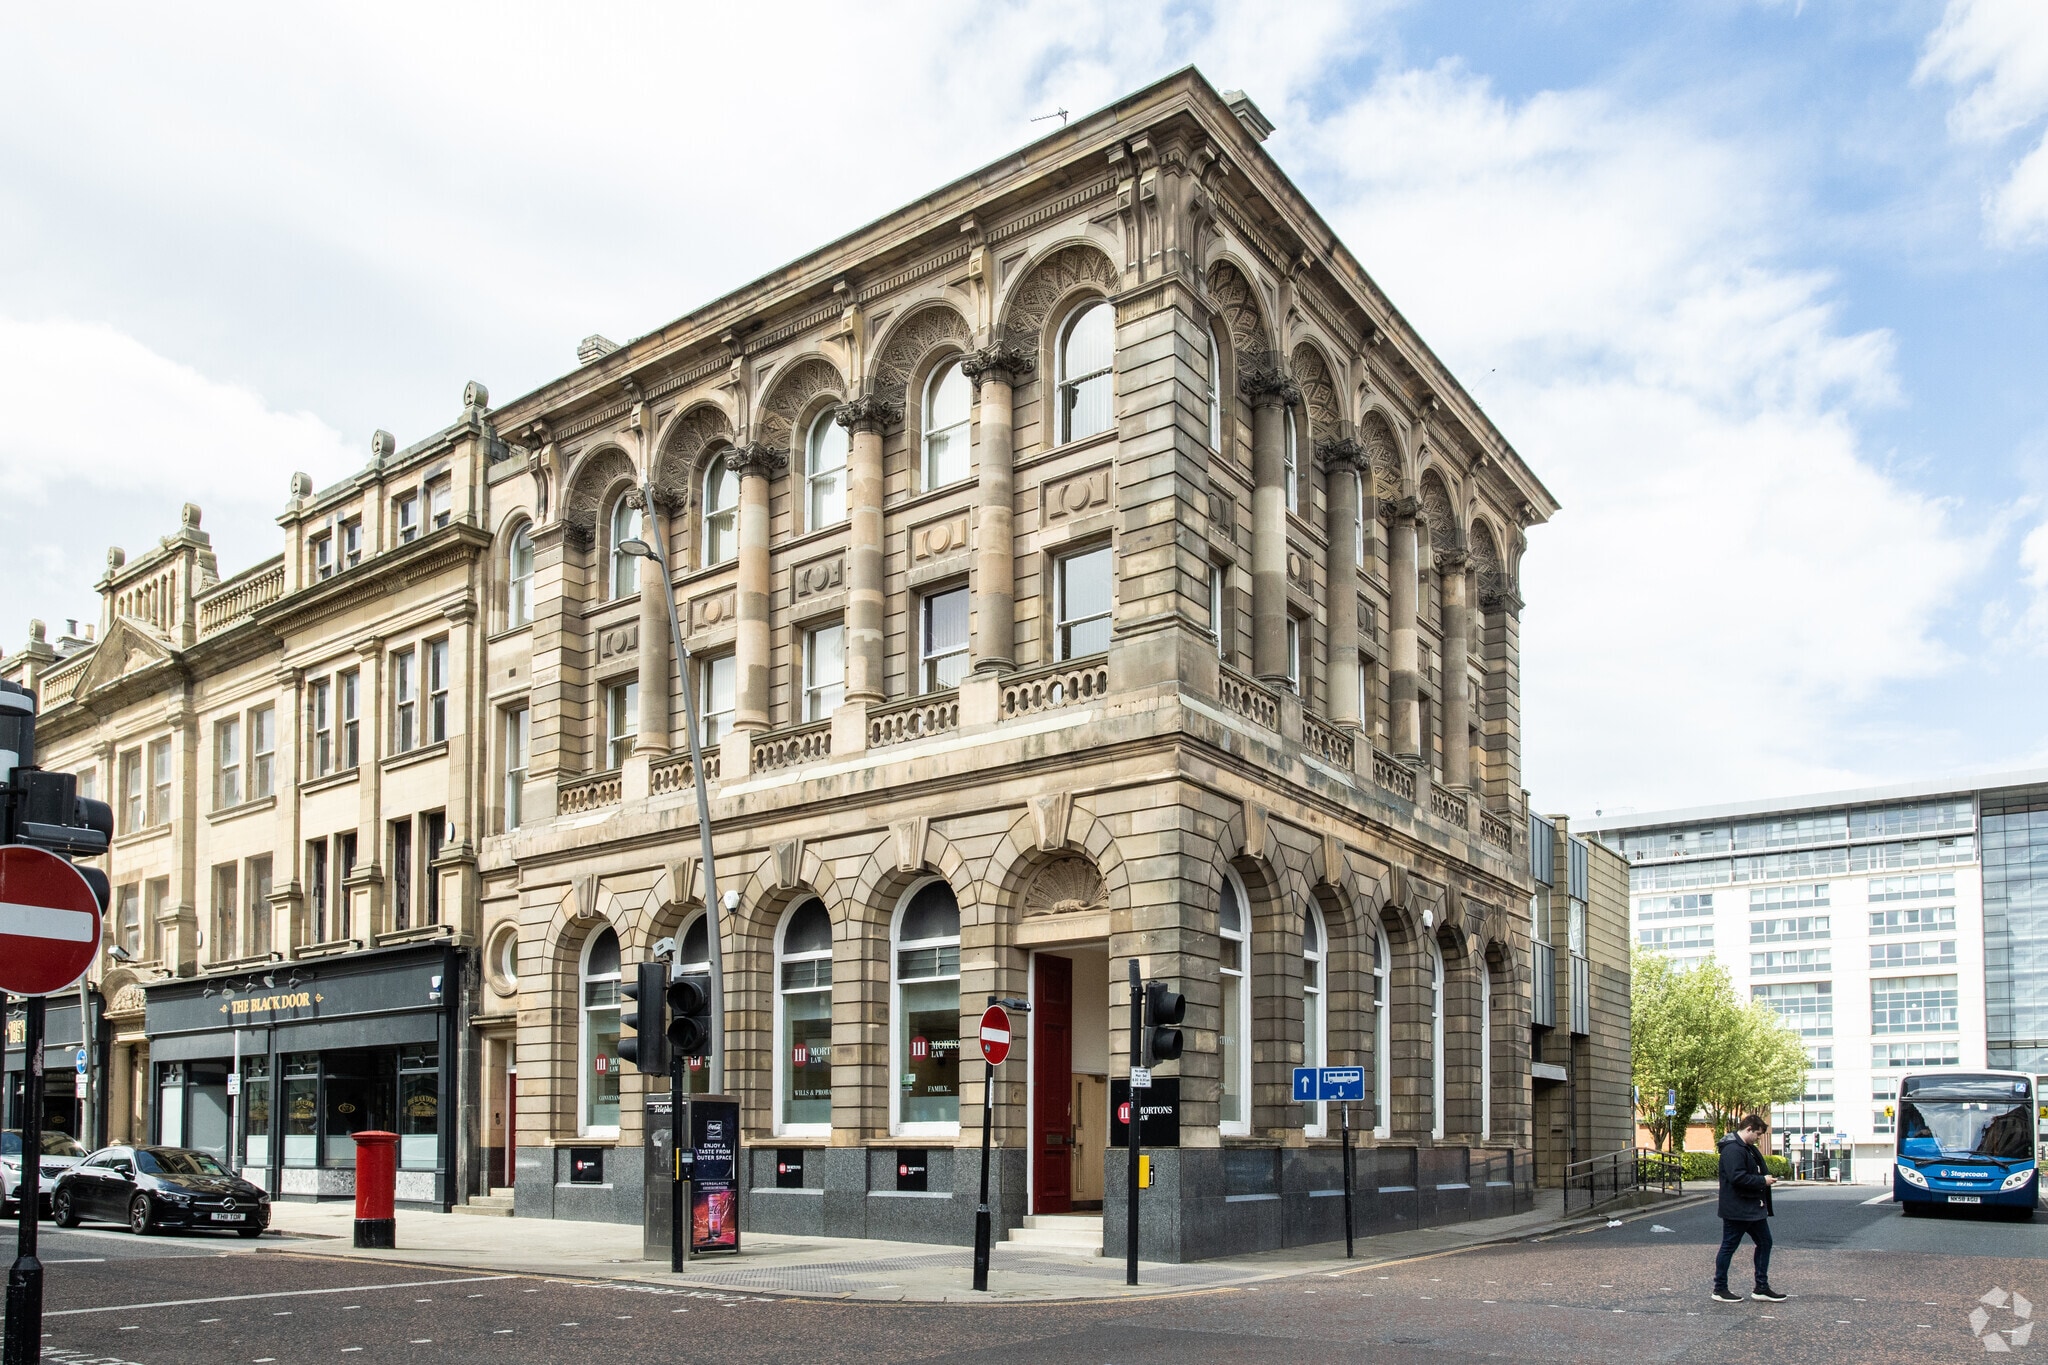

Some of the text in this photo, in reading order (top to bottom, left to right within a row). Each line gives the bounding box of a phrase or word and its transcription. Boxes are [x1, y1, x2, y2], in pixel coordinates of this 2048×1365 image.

[231, 992, 310, 1014] THE BLACK DOOR
[931, 1040, 960, 1050] MORTO
[810, 1046, 832, 1056] MORT
[931, 1050, 945, 1058] LAW
[810, 1056, 822, 1064] LAW
[654, 1104, 672, 1115] Telepho
[1950, 1170, 1988, 1178] Stagecoach
